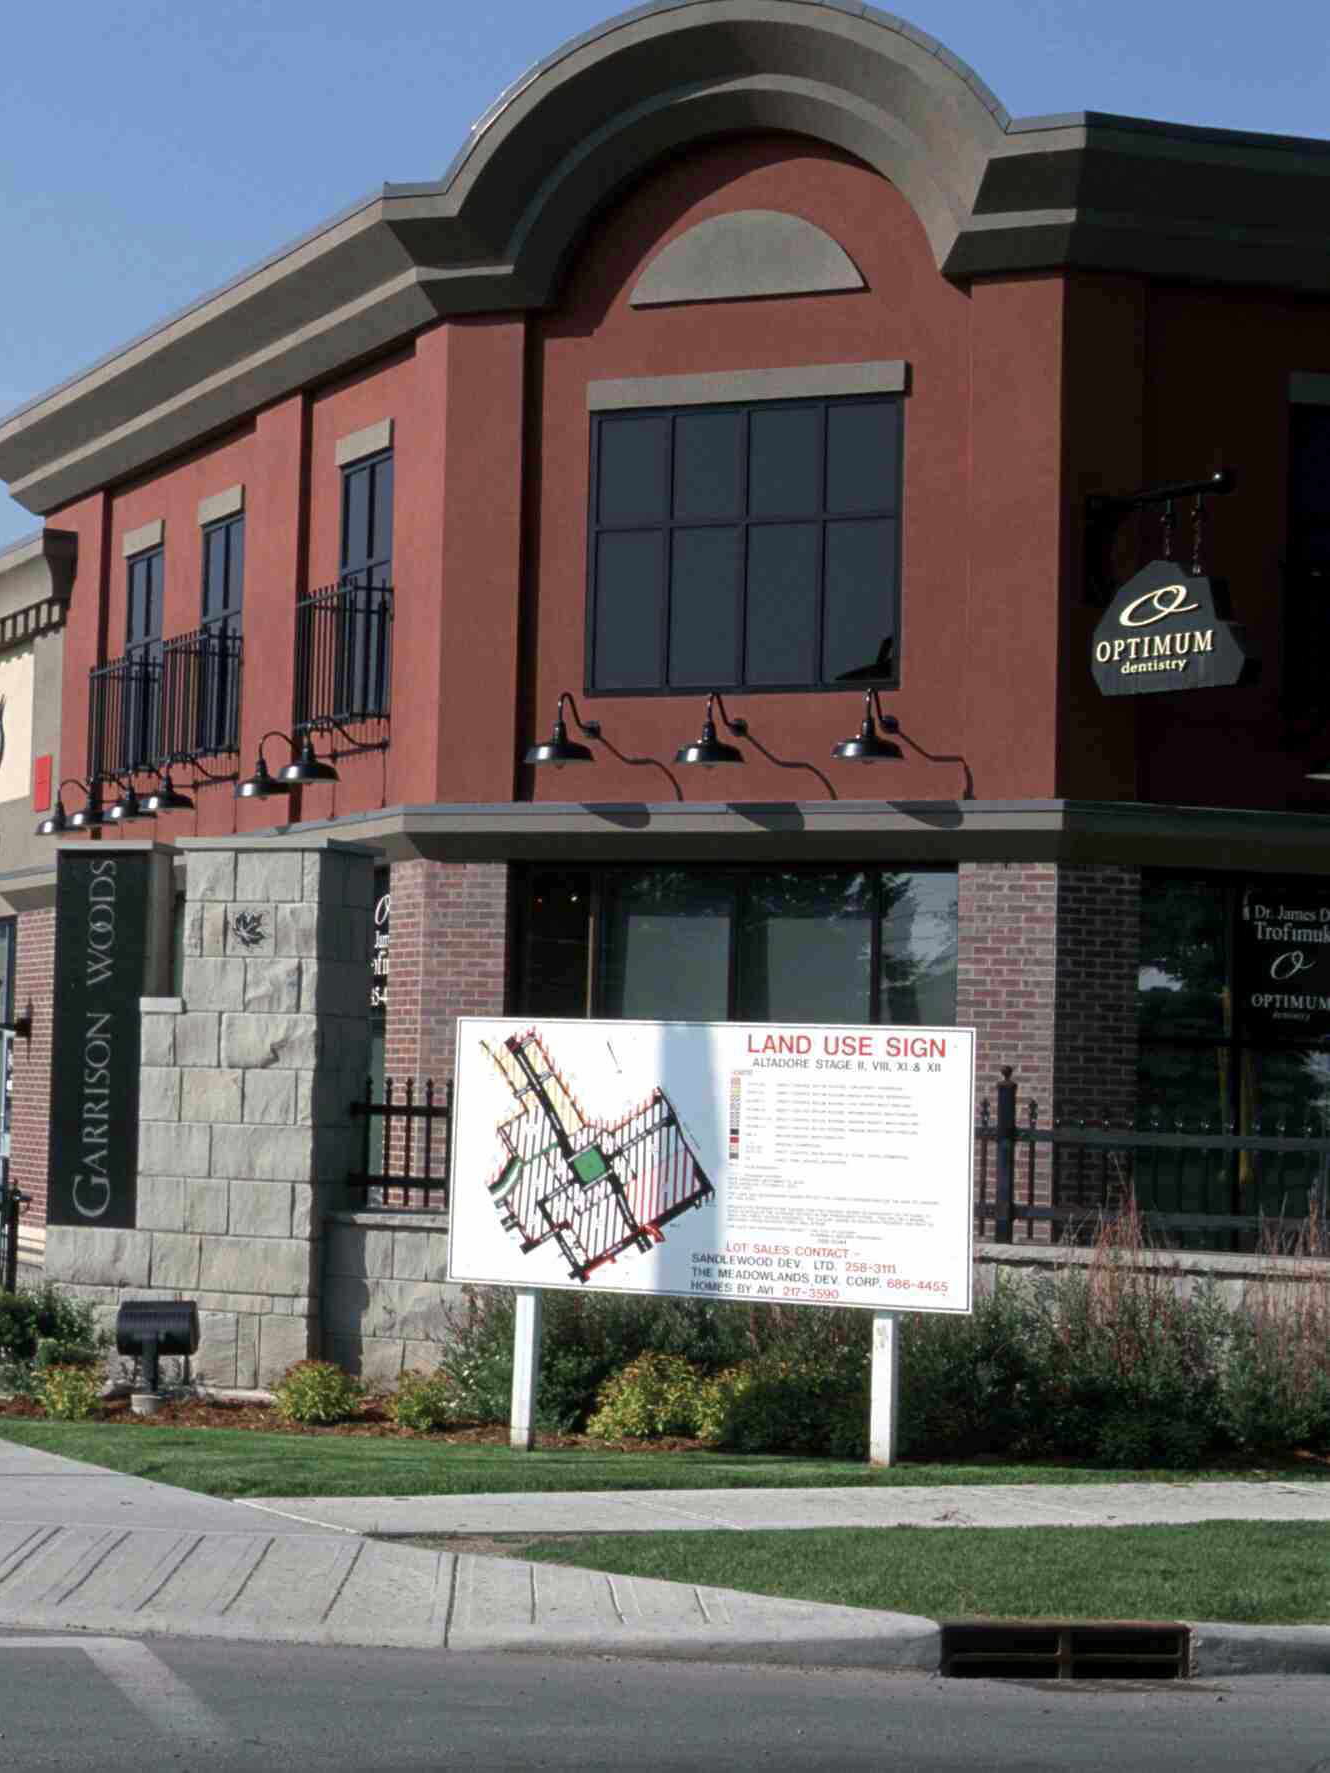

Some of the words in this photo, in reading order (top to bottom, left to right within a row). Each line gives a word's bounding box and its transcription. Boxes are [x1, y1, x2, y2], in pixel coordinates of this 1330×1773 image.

[1095, 629, 1214, 663] OPTIMUM
[1120, 658, 1187, 674] dentistry
[1277, 904, 1317, 922] James
[85, 859, 117, 988] WOODS
[747, 1034, 812, 1054] LAND
[824, 1036, 873, 1056] USE
[886, 1037, 946, 1058] SIGN
[752, 1057, 810, 1069] ALTADORE
[815, 1058, 853, 1070] STAGE
[897, 1061, 908, 1072] XI
[913, 1062, 921, 1073] &
[926, 1062, 942, 1073] XII
[72, 1012, 113, 1218] GARRISON
[726, 1240, 748, 1253] LOT
[753, 1243, 790, 1256] SALES
[795, 1246, 850, 1259] CONTACT
[691, 1253, 773, 1268] SANDLEWOOD
[777, 1257, 804, 1270] DEV.
[813, 1260, 838, 1272] LTD.
[691, 1266, 713, 1278] THE
[717, 1268, 810, 1284] MEADOWLANDS
[814, 1274, 841, 1286] DEV.
[690, 1280, 733, 1293] HOMES
[737, 1282, 753, 1294] BY
[757, 1284, 774, 1295] AVI
